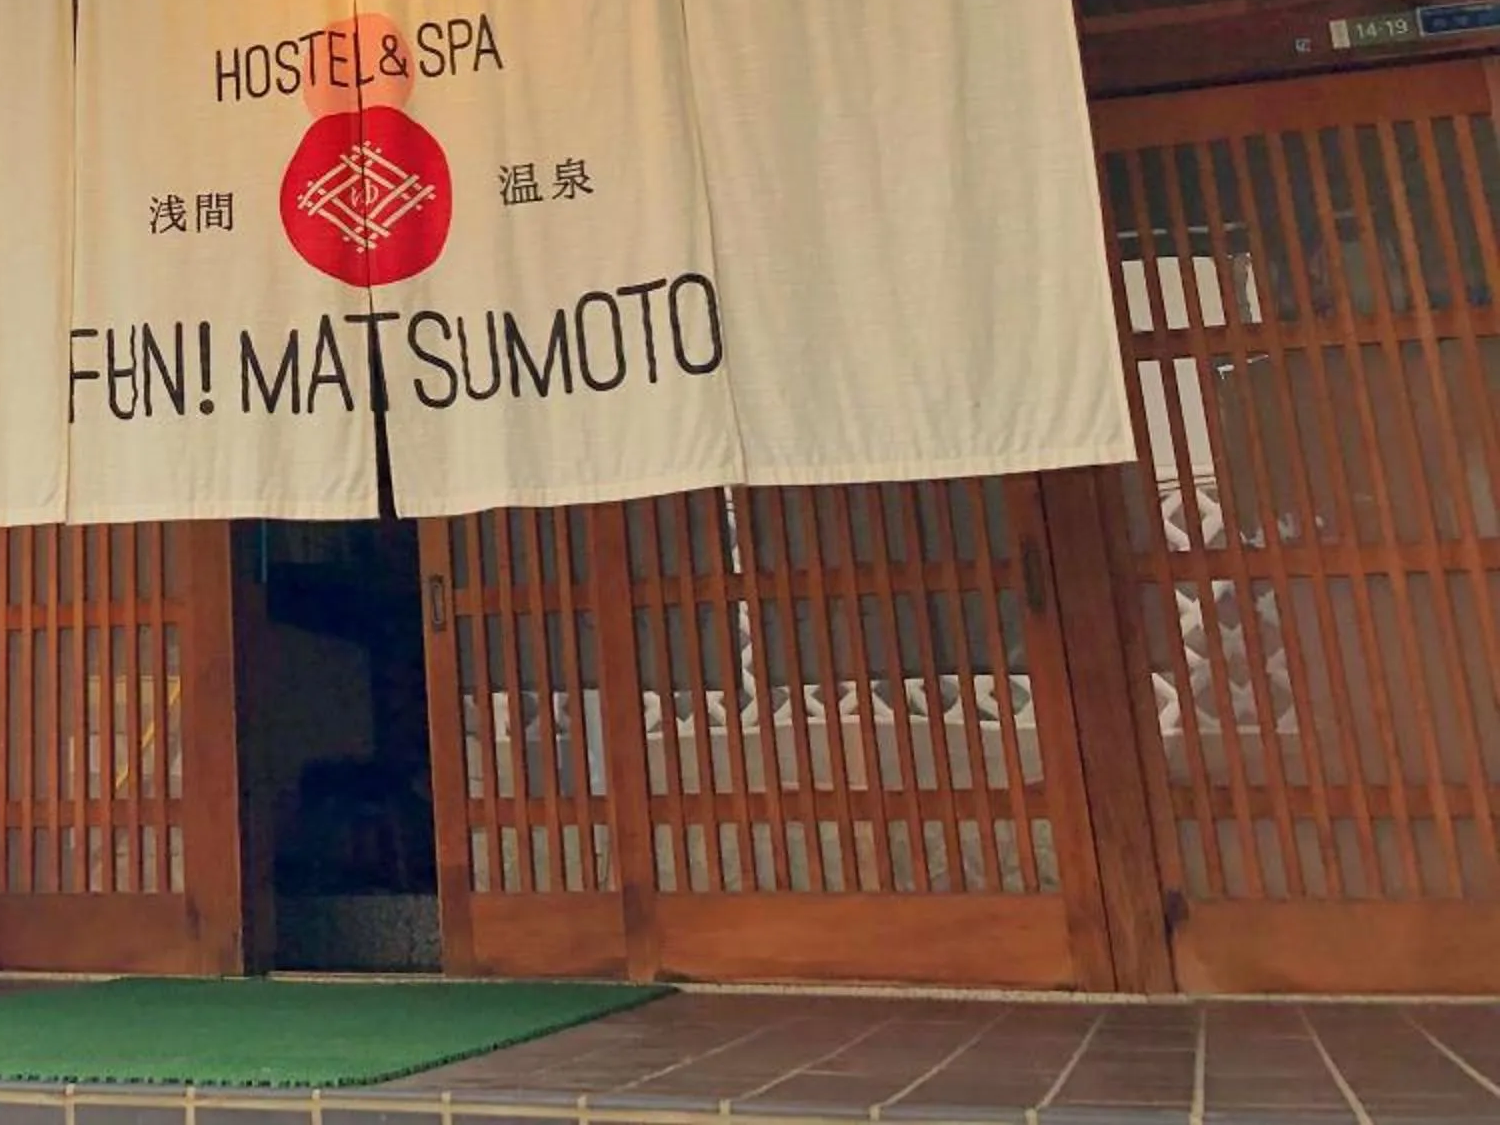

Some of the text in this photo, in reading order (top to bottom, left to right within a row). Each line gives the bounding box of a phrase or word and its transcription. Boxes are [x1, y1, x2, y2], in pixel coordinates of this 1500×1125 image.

[215, 30, 374, 101] HOSTEL
[416, 13, 504, 77] SPA
[148, 158, 594, 234] 浅間 温泉
[67, 272, 724, 424] FUN! MATSUMOTO
